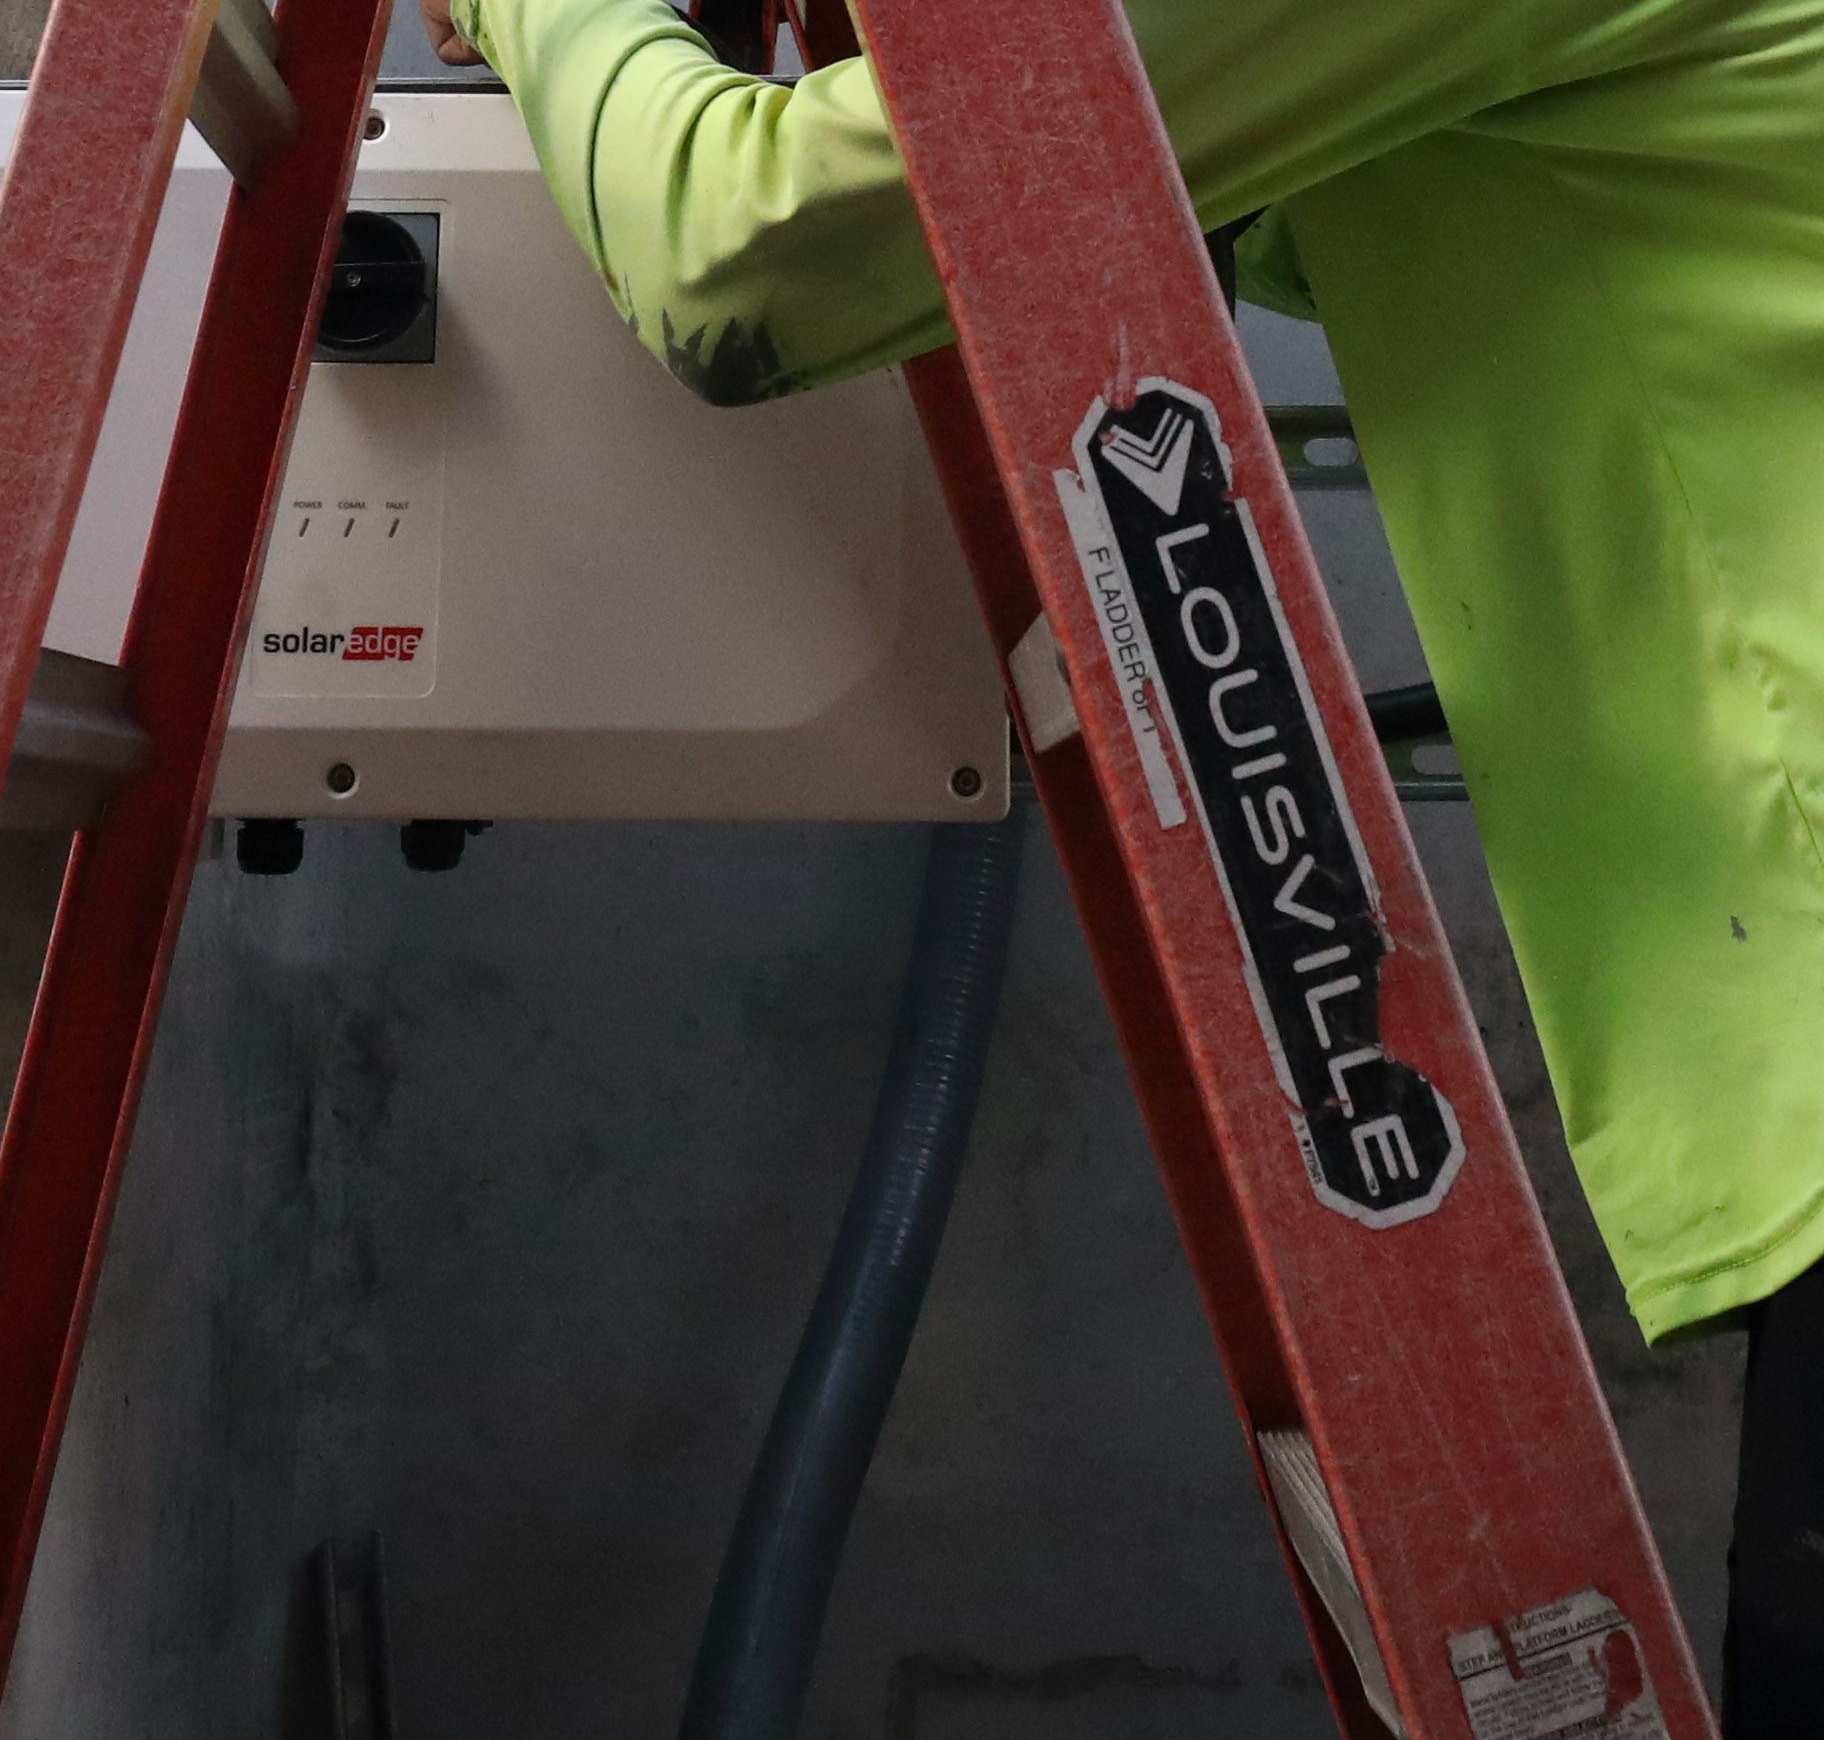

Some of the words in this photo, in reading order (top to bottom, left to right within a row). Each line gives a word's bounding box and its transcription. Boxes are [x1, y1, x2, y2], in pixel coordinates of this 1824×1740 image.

[293, 501, 323, 510] POWER
[385, 501, 410, 510] FAULT
[263, 626, 420, 660] solaredge
[1094, 570, 1147, 682] LADDER
[1155, 522, 1421, 1198] LOUISVILLE
